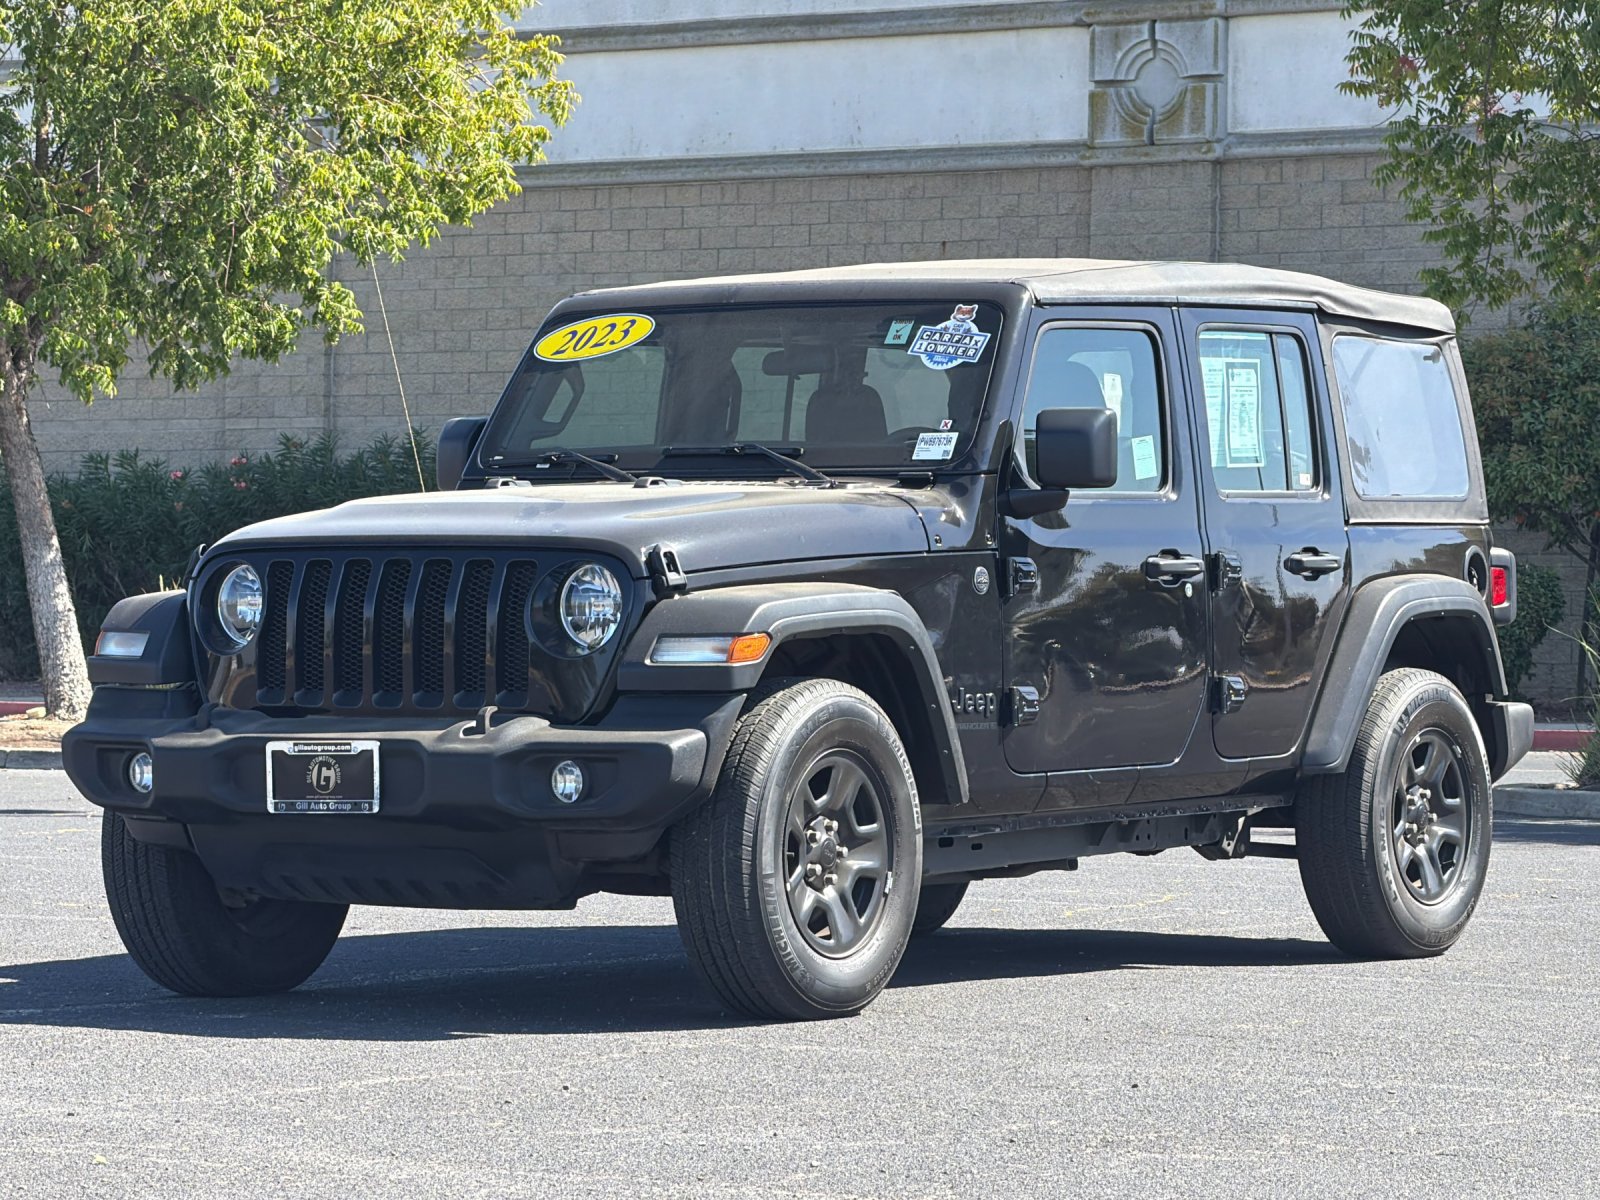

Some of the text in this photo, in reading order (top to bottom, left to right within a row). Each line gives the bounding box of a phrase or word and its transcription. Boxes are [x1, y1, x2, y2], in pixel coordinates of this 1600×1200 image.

[551, 319, 637, 356] 2023
[922, 331, 982, 347] CARFAX
[926, 343, 977, 357] OWNER
[951, 687, 997, 717] Jeep
[294, 744, 351, 752] gillautogroup.com
[295, 802, 352, 811] Gill Auto Group
